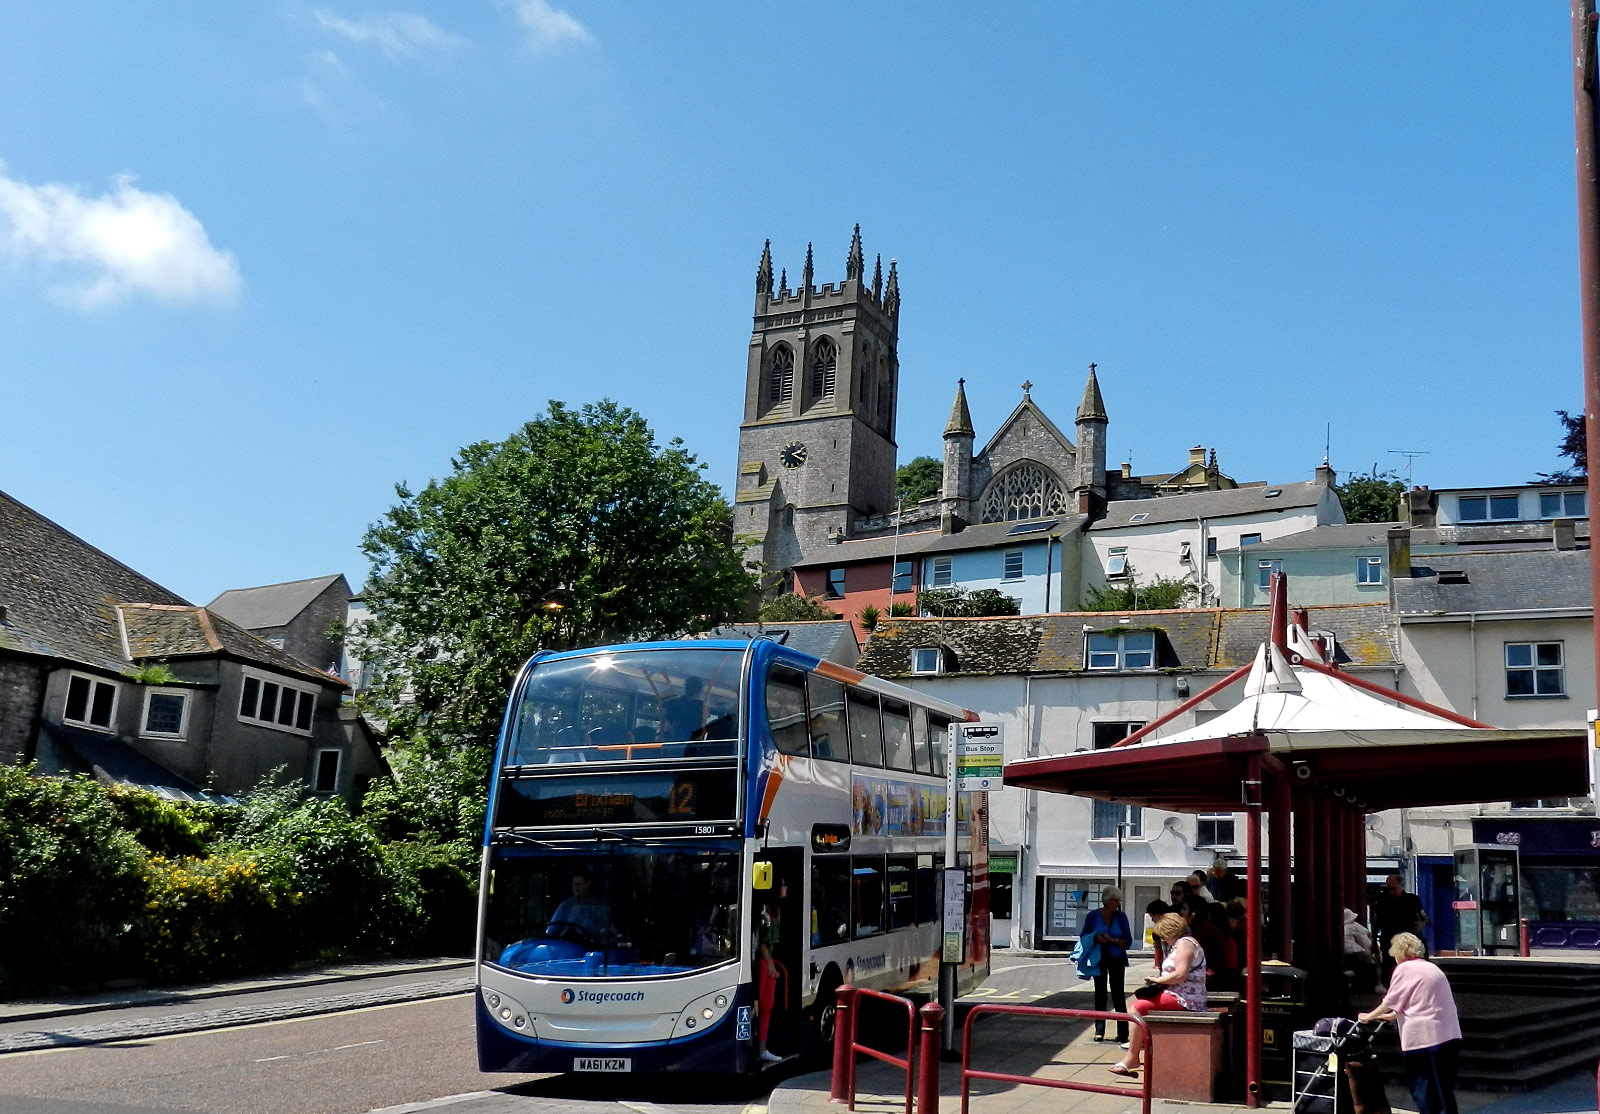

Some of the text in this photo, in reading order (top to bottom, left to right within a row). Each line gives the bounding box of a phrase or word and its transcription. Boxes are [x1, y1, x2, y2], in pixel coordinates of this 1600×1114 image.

[575, 790, 634, 808] Brixham
[668, 783, 695, 814] 12
[694, 825, 716, 834] 15801
[857, 953, 886, 973] Stagecoach
[578, 990, 645, 1005] Stagecoach
[579, 1059, 626, 1070] WA61 KZM
